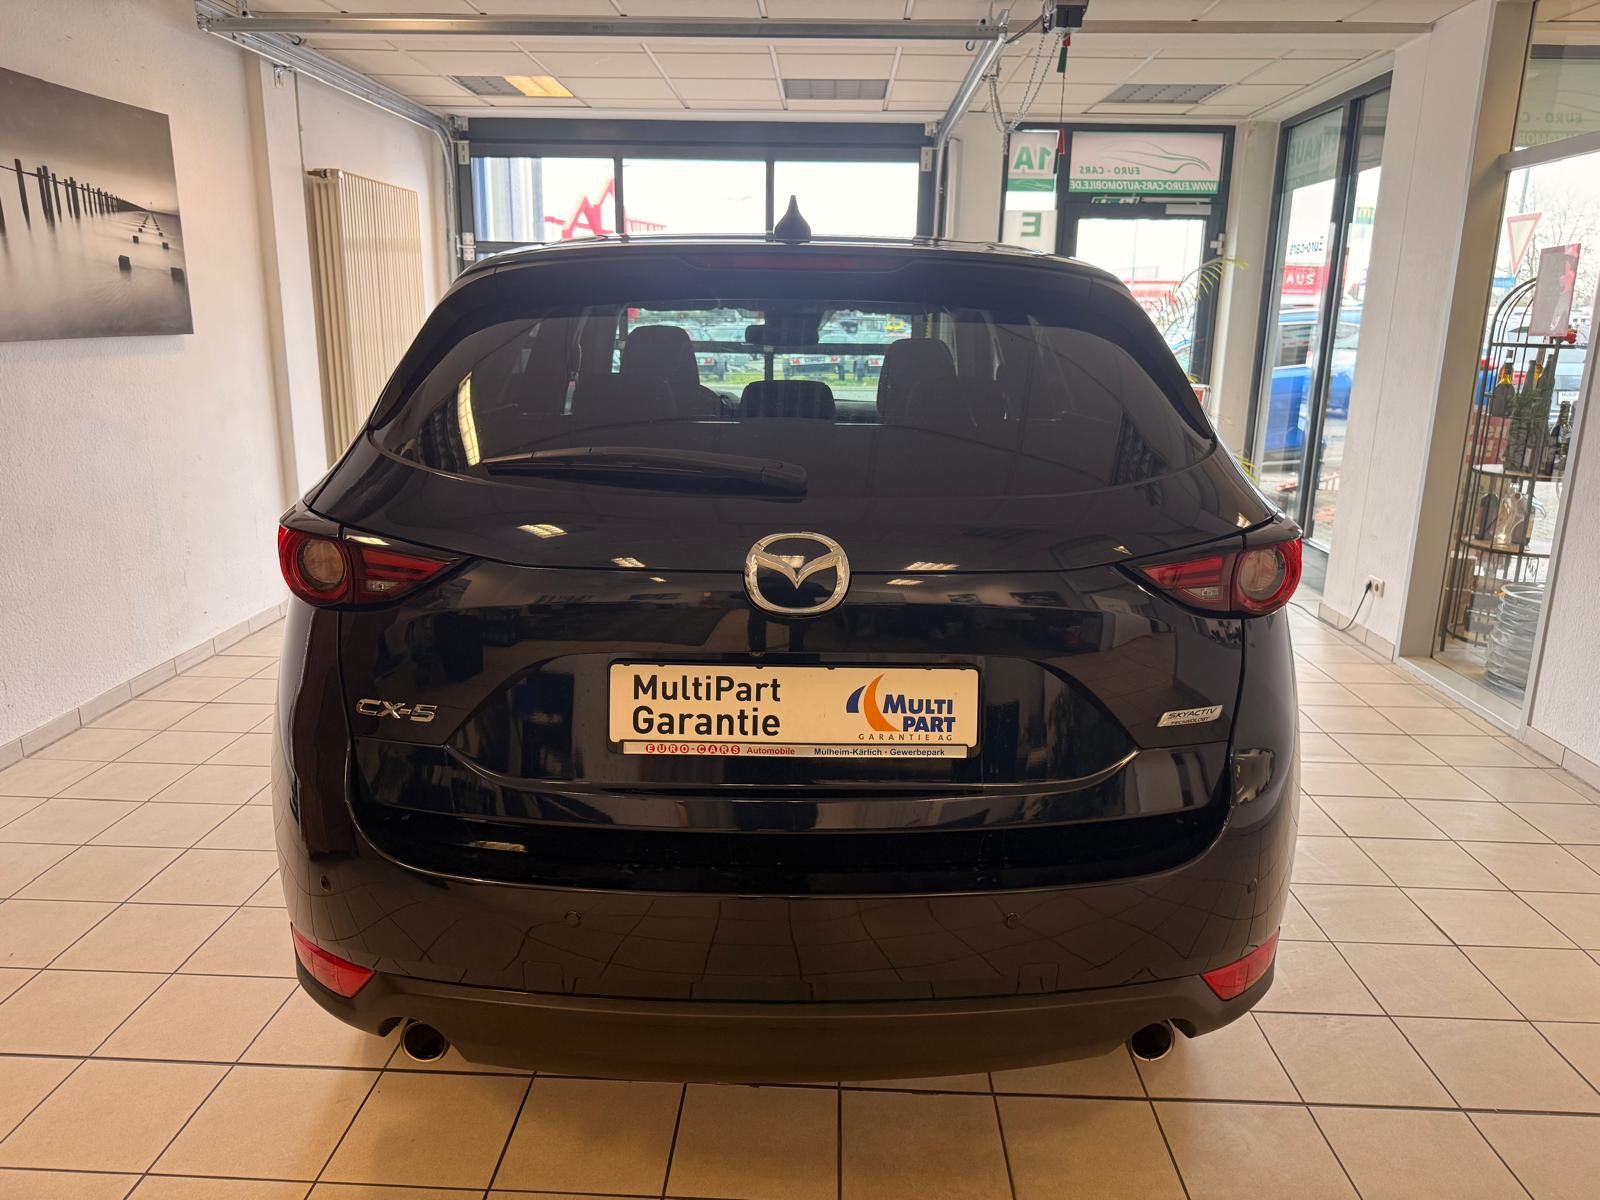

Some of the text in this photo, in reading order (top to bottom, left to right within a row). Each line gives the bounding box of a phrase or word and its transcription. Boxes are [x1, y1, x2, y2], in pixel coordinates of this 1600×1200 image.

[633, 674, 781, 702] MultiPart
[356, 698, 438, 723] CX-5
[882, 694, 953, 715] MULTI
[1168, 707, 1218, 719] SKYACTIV
[632, 705, 781, 737] Garantie
[902, 716, 956, 733] PART
[858, 733, 930, 741] GARANTIE
[645, 743, 741, 755] EURO-CARS
[746, 746, 796, 756] Automobile
[889, 748, 945, 758] Gewerbepark
